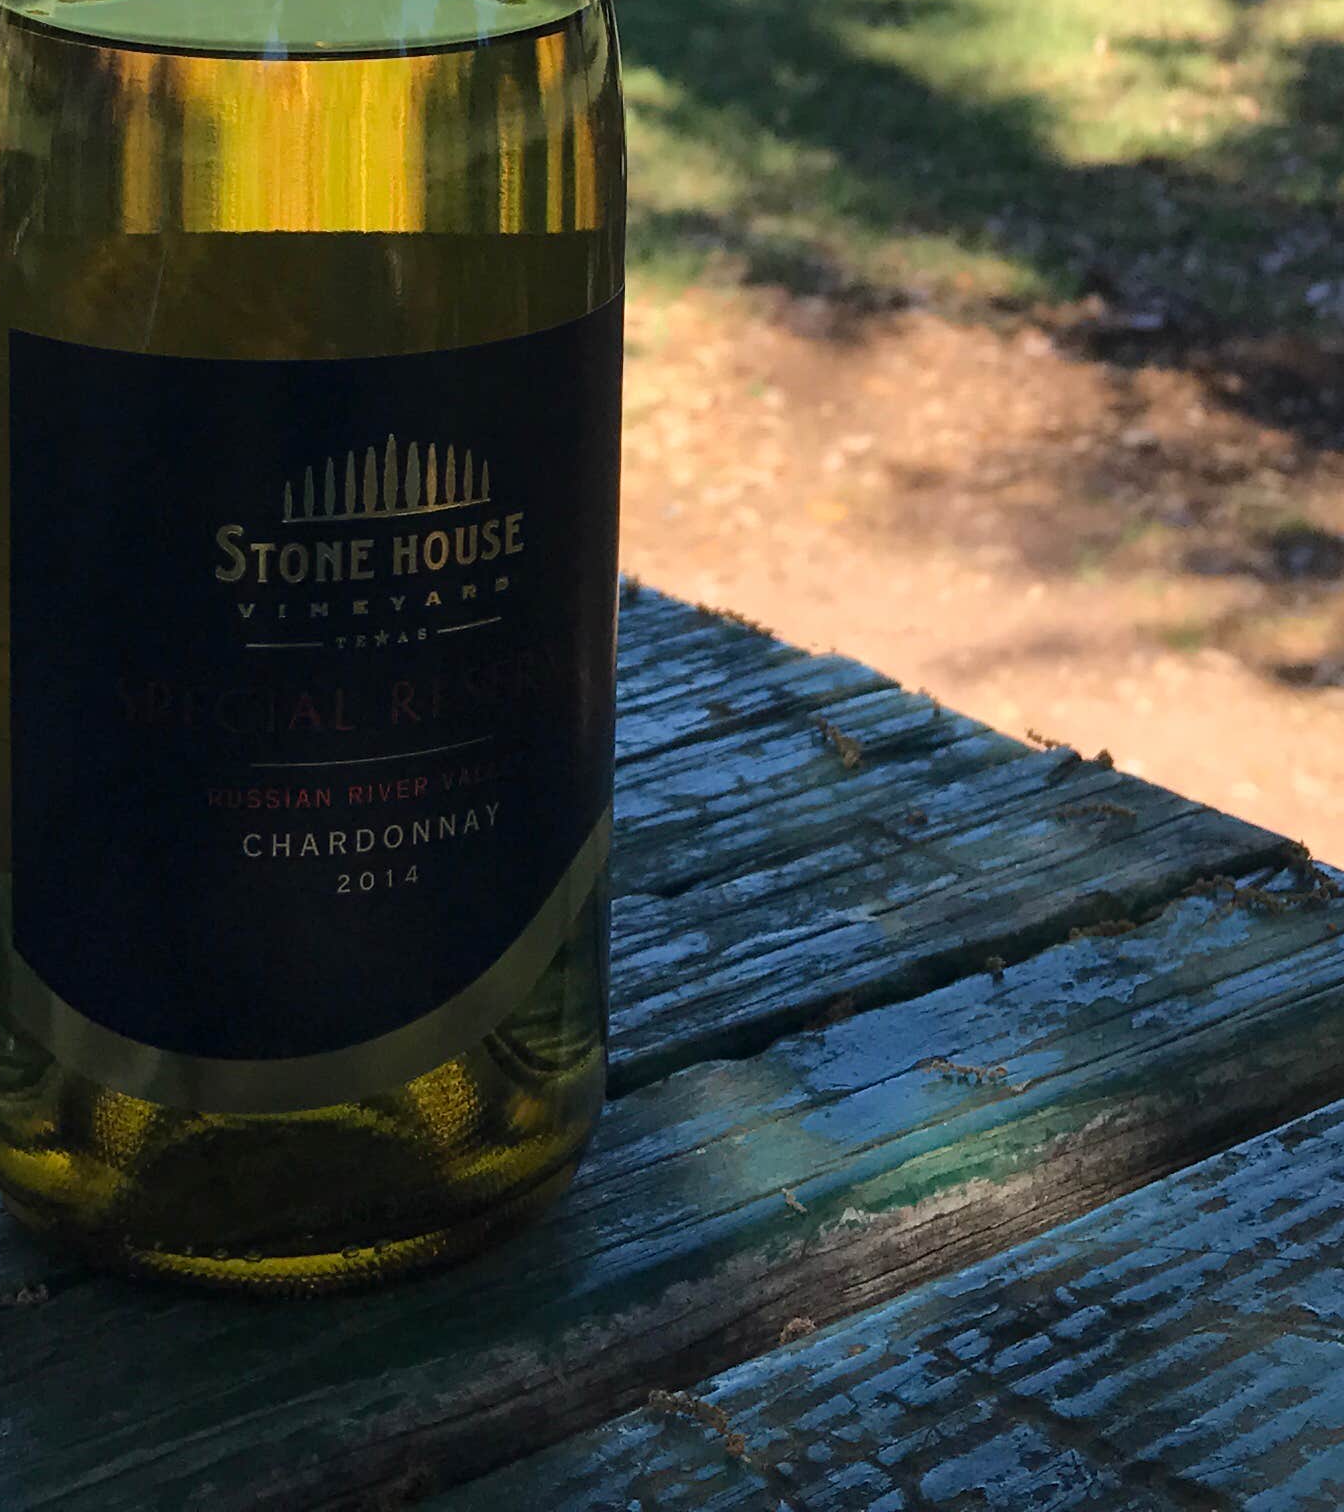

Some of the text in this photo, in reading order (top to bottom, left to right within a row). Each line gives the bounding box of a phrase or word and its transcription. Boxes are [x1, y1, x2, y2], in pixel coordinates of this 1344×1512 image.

[214, 512, 526, 584] STONE HOUSE
[236, 578, 512, 619] VINEYARD
[208, 788, 332, 809] RUSSIAN
[348, 776, 429, 805] RIVER
[242, 802, 501, 858] CHARDONNAY
[336, 865, 420, 893] 2014
